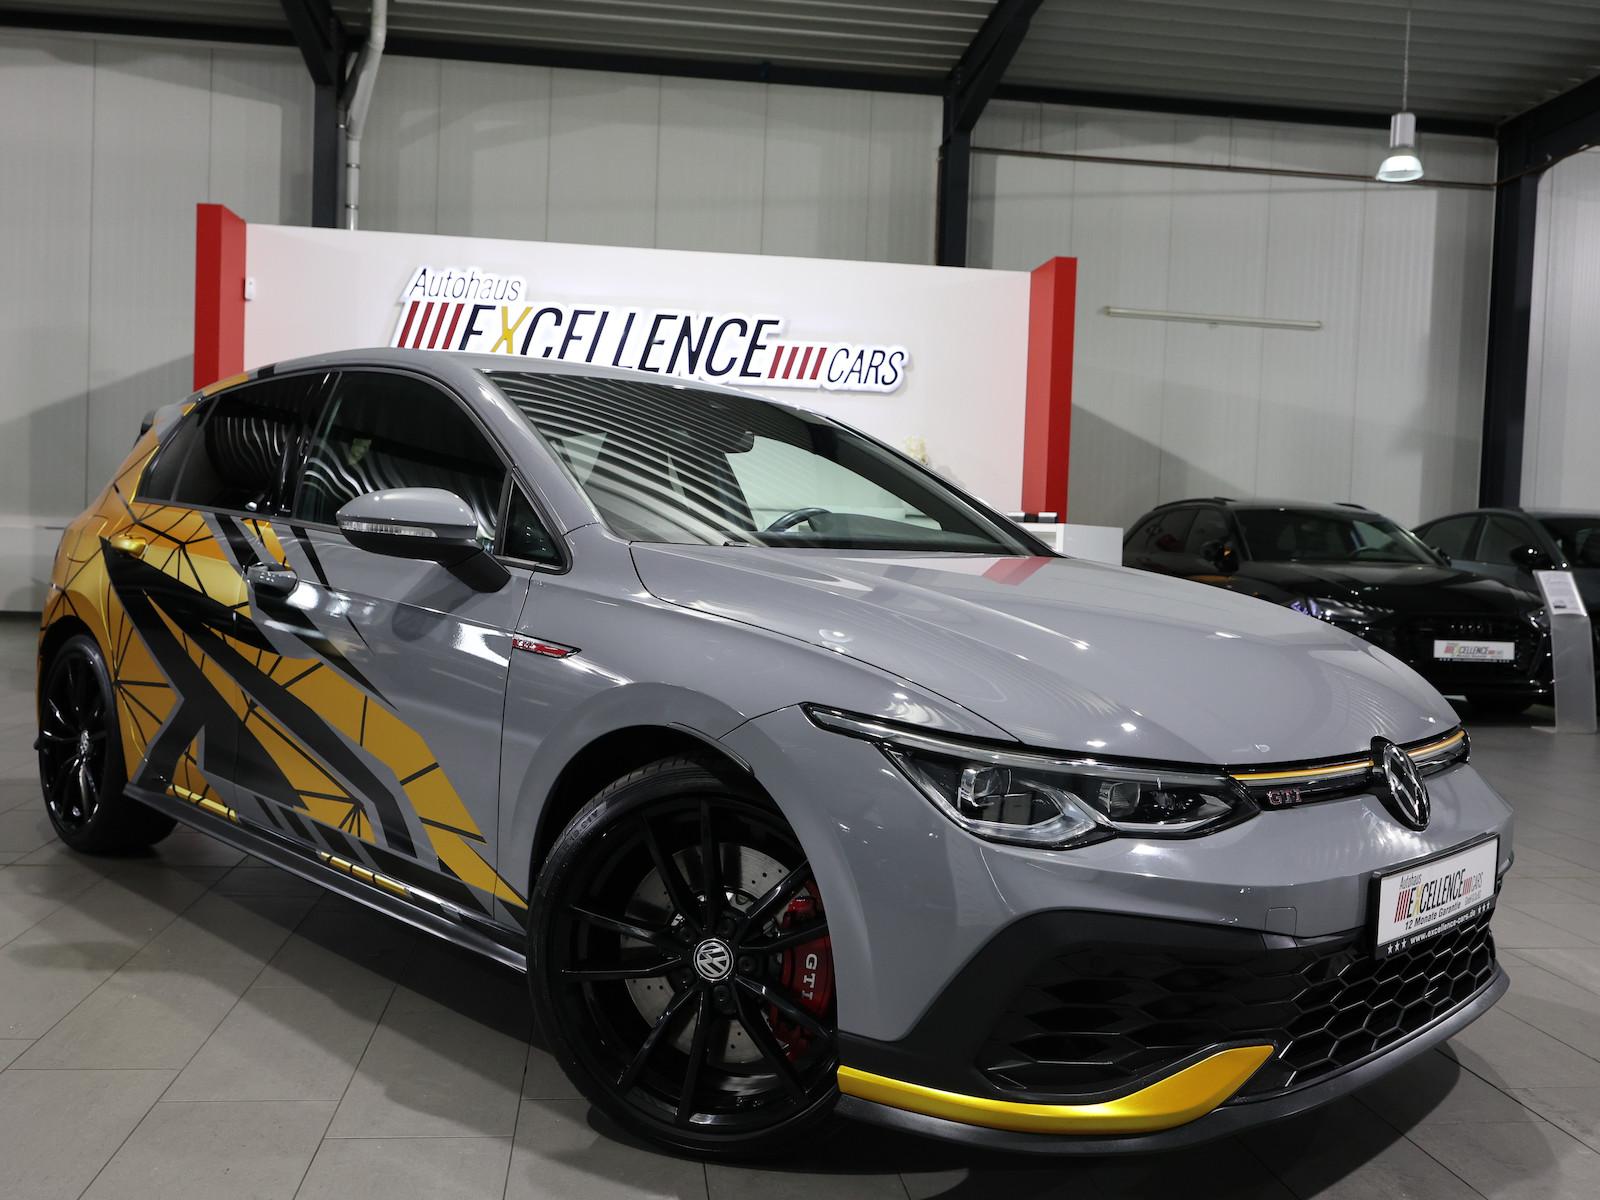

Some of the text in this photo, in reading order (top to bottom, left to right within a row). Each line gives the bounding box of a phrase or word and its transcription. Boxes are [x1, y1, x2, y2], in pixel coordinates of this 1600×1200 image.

[409, 268, 521, 302] Autohaus
[458, 304, 905, 386] EXCELLENCE CARS
[1406, 868, 1466, 919] EXCELLENCE
[1405, 920, 1413, 931] 12
[1414, 911, 1438, 927] Monate
[802, 953, 817, 1000] GTI
